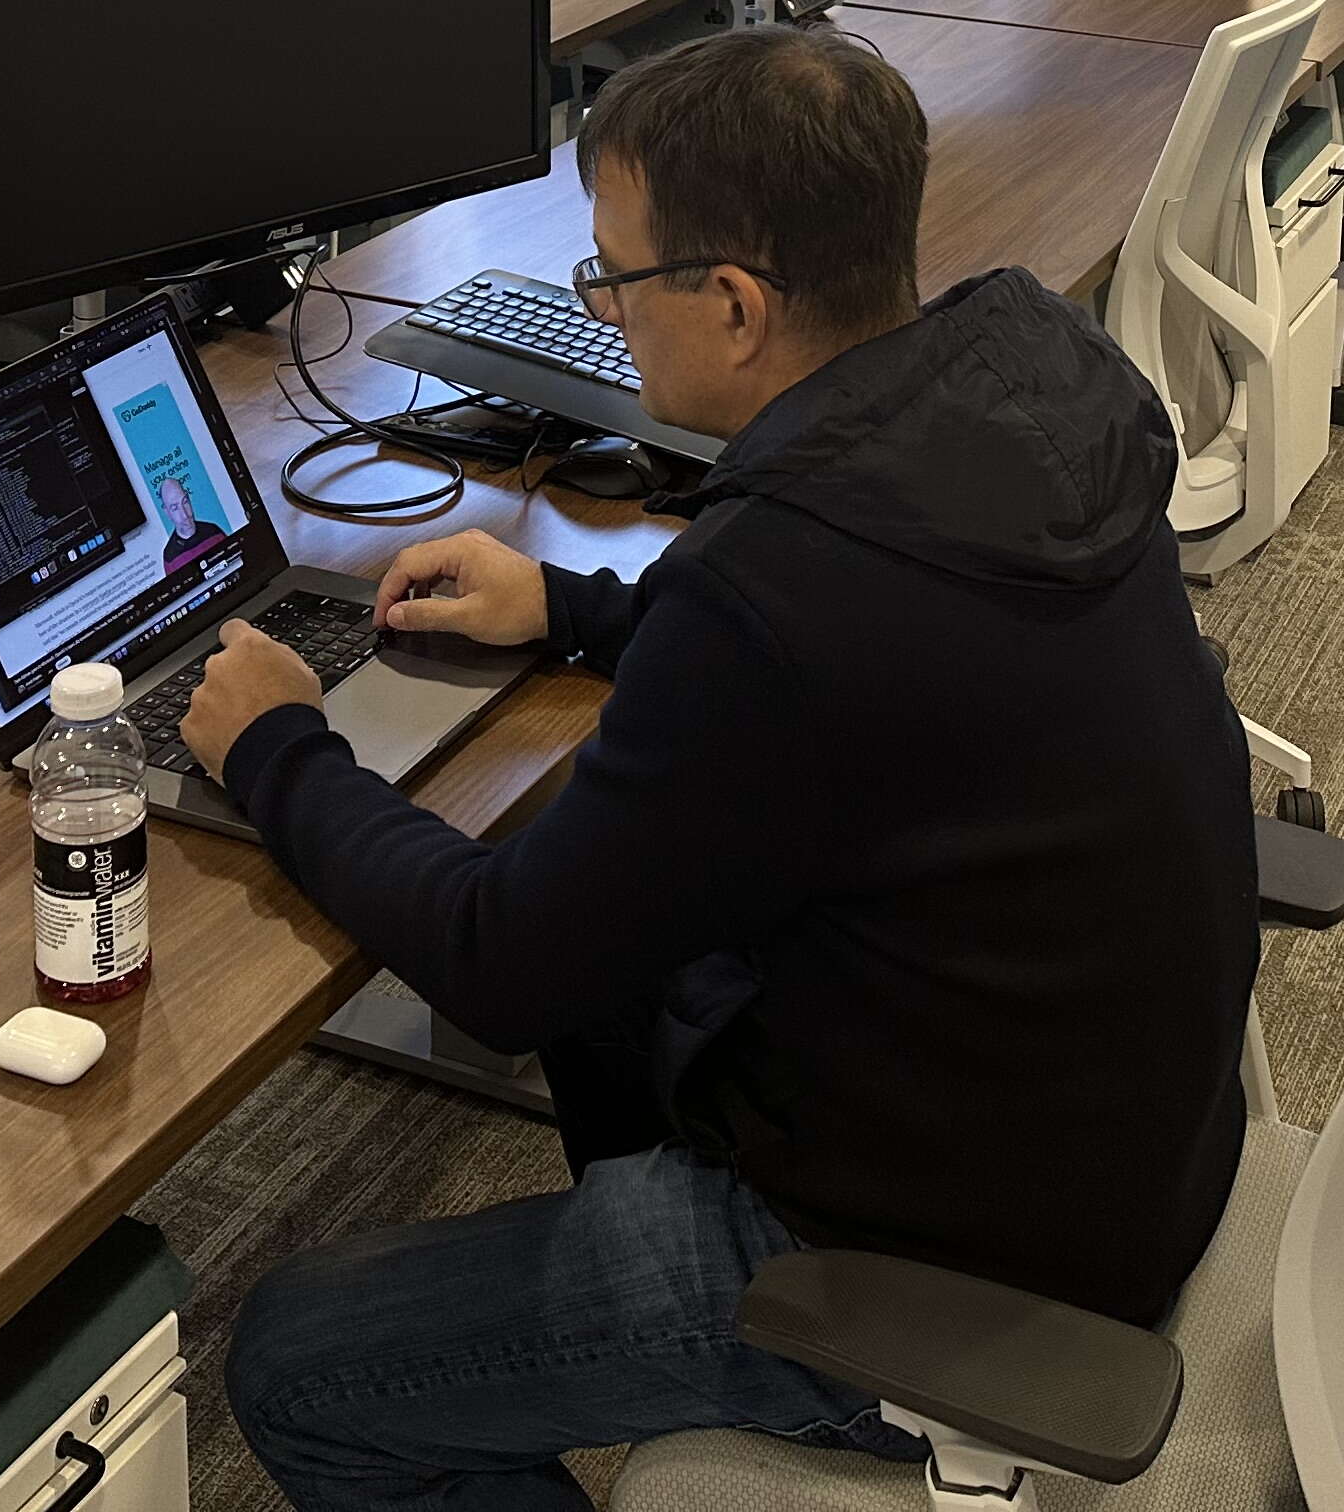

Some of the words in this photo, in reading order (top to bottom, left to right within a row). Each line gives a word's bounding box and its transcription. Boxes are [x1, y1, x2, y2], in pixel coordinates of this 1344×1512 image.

[266, 223, 304, 242] ASUS
[130, 399, 157, 417] GoDaddy
[143, 452, 174, 474] Manage
[174, 445, 183, 458] all
[167, 459, 190, 476] online
[90, 848, 115, 978] vitaminwater
